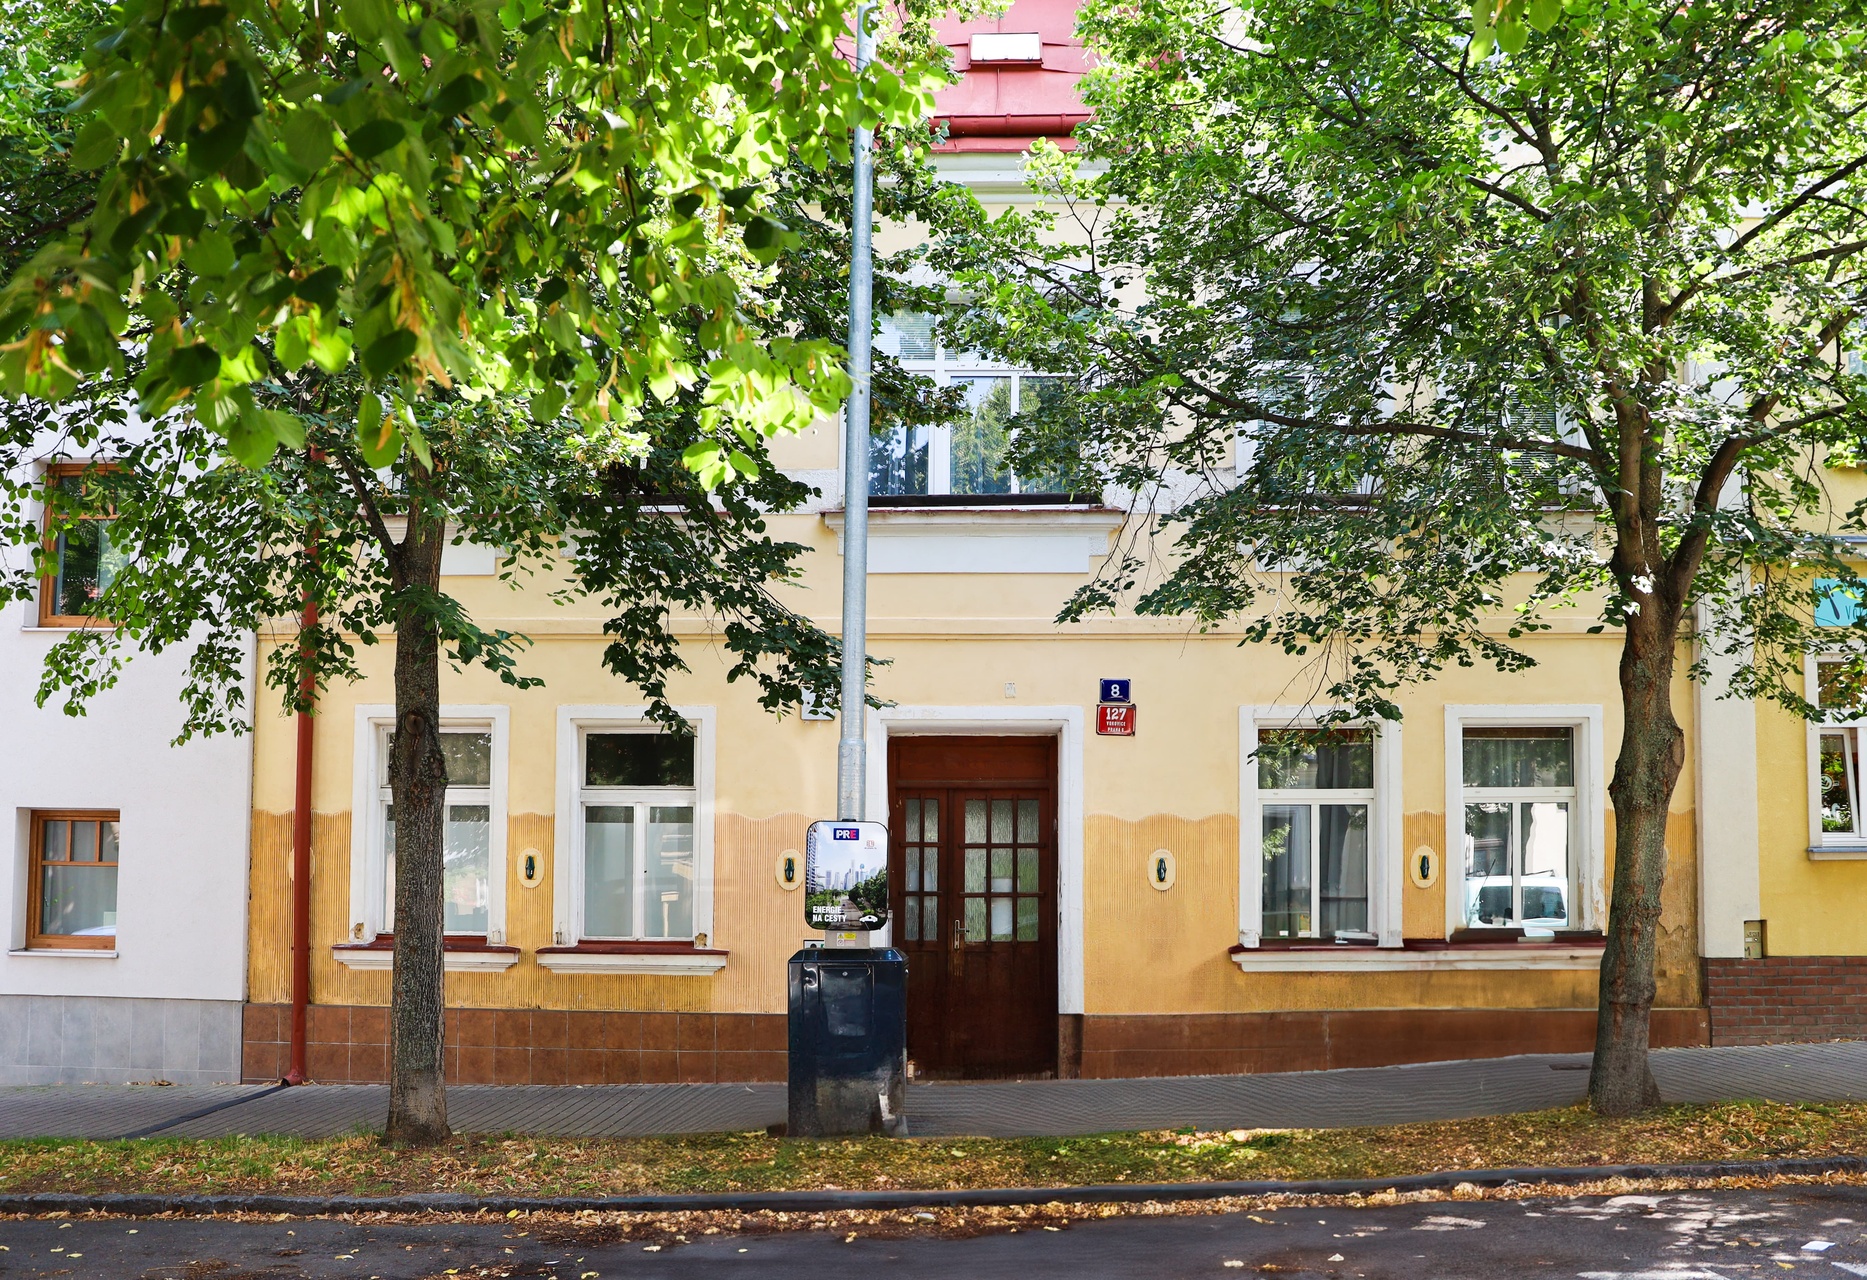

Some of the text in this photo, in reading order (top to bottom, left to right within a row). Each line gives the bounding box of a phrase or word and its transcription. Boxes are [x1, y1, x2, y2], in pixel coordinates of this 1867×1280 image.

[1110, 684, 1120, 697] 8
[1106, 708, 1127, 720] 127
[835, 829, 857, 839] PRE
[812, 905, 842, 914] ENERGIE
[812, 914, 847, 922] NA CESTY
